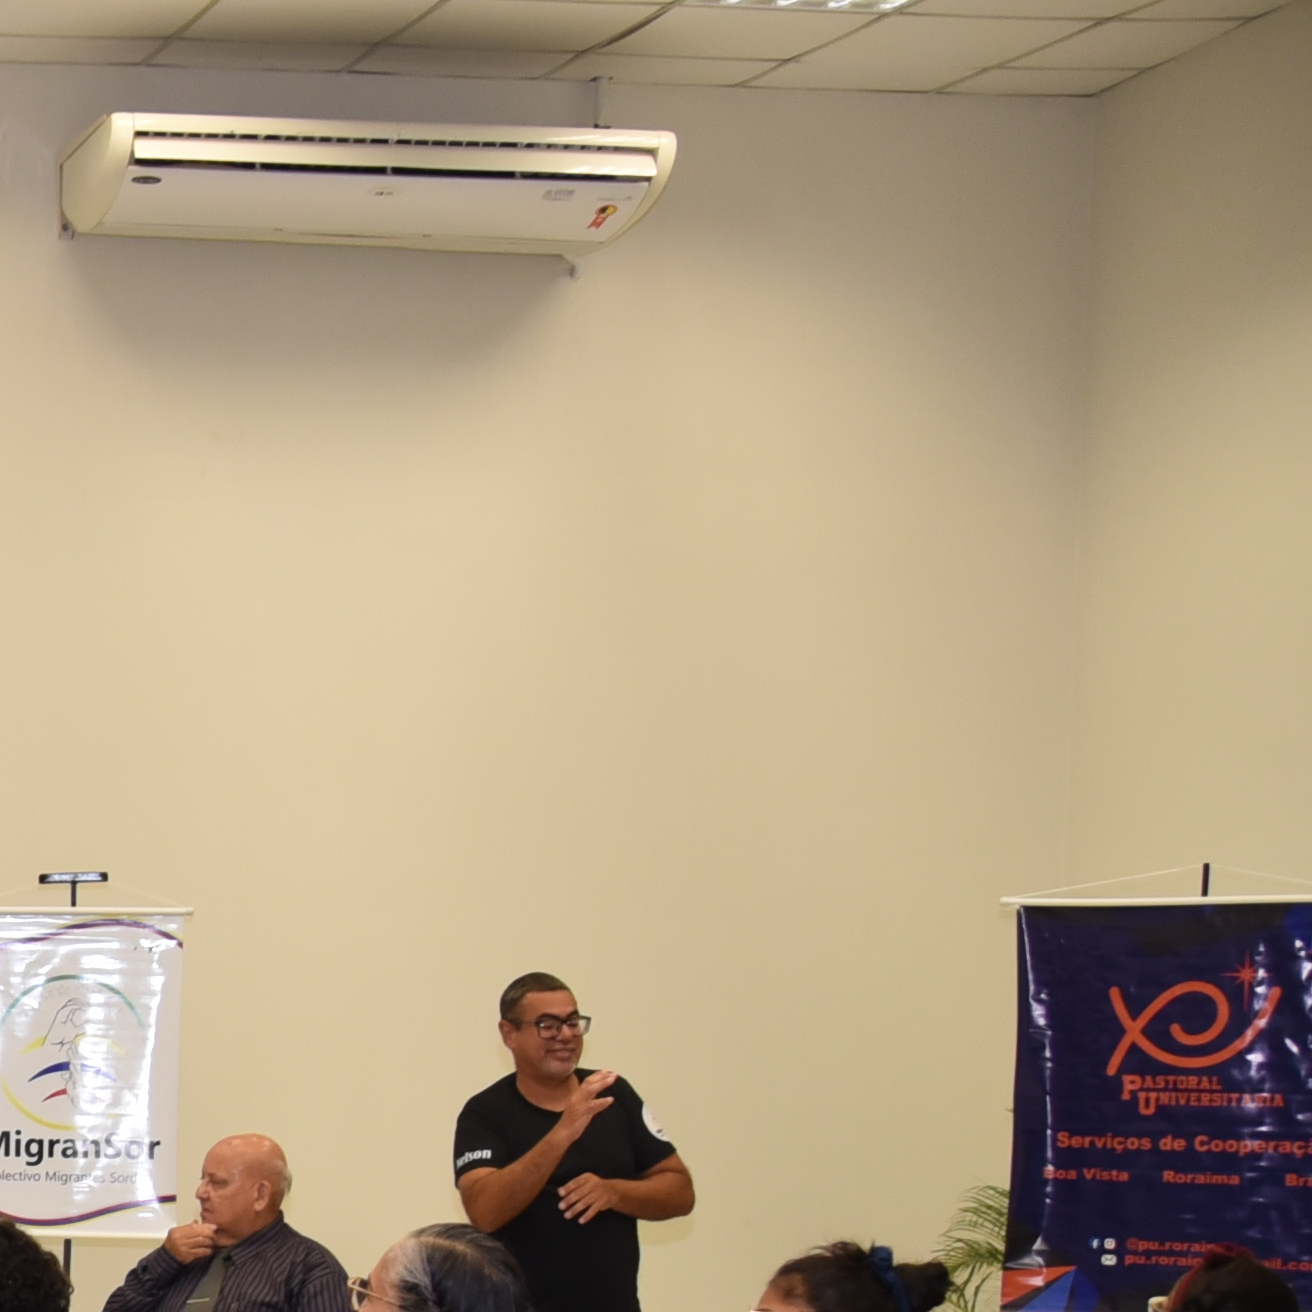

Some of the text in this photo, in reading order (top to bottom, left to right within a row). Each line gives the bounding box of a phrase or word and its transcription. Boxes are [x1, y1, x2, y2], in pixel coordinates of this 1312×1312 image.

[1121, 1074, 1222, 1100] PASTORAL
[1056, 1131, 1152, 1154] Serviços
[1158, 1134, 1187, 1151] de
[1043, 1165, 1077, 1180] Boa
[1082, 1168, 1130, 1182] Vista
[1162, 1170, 1241, 1185] Roraima
